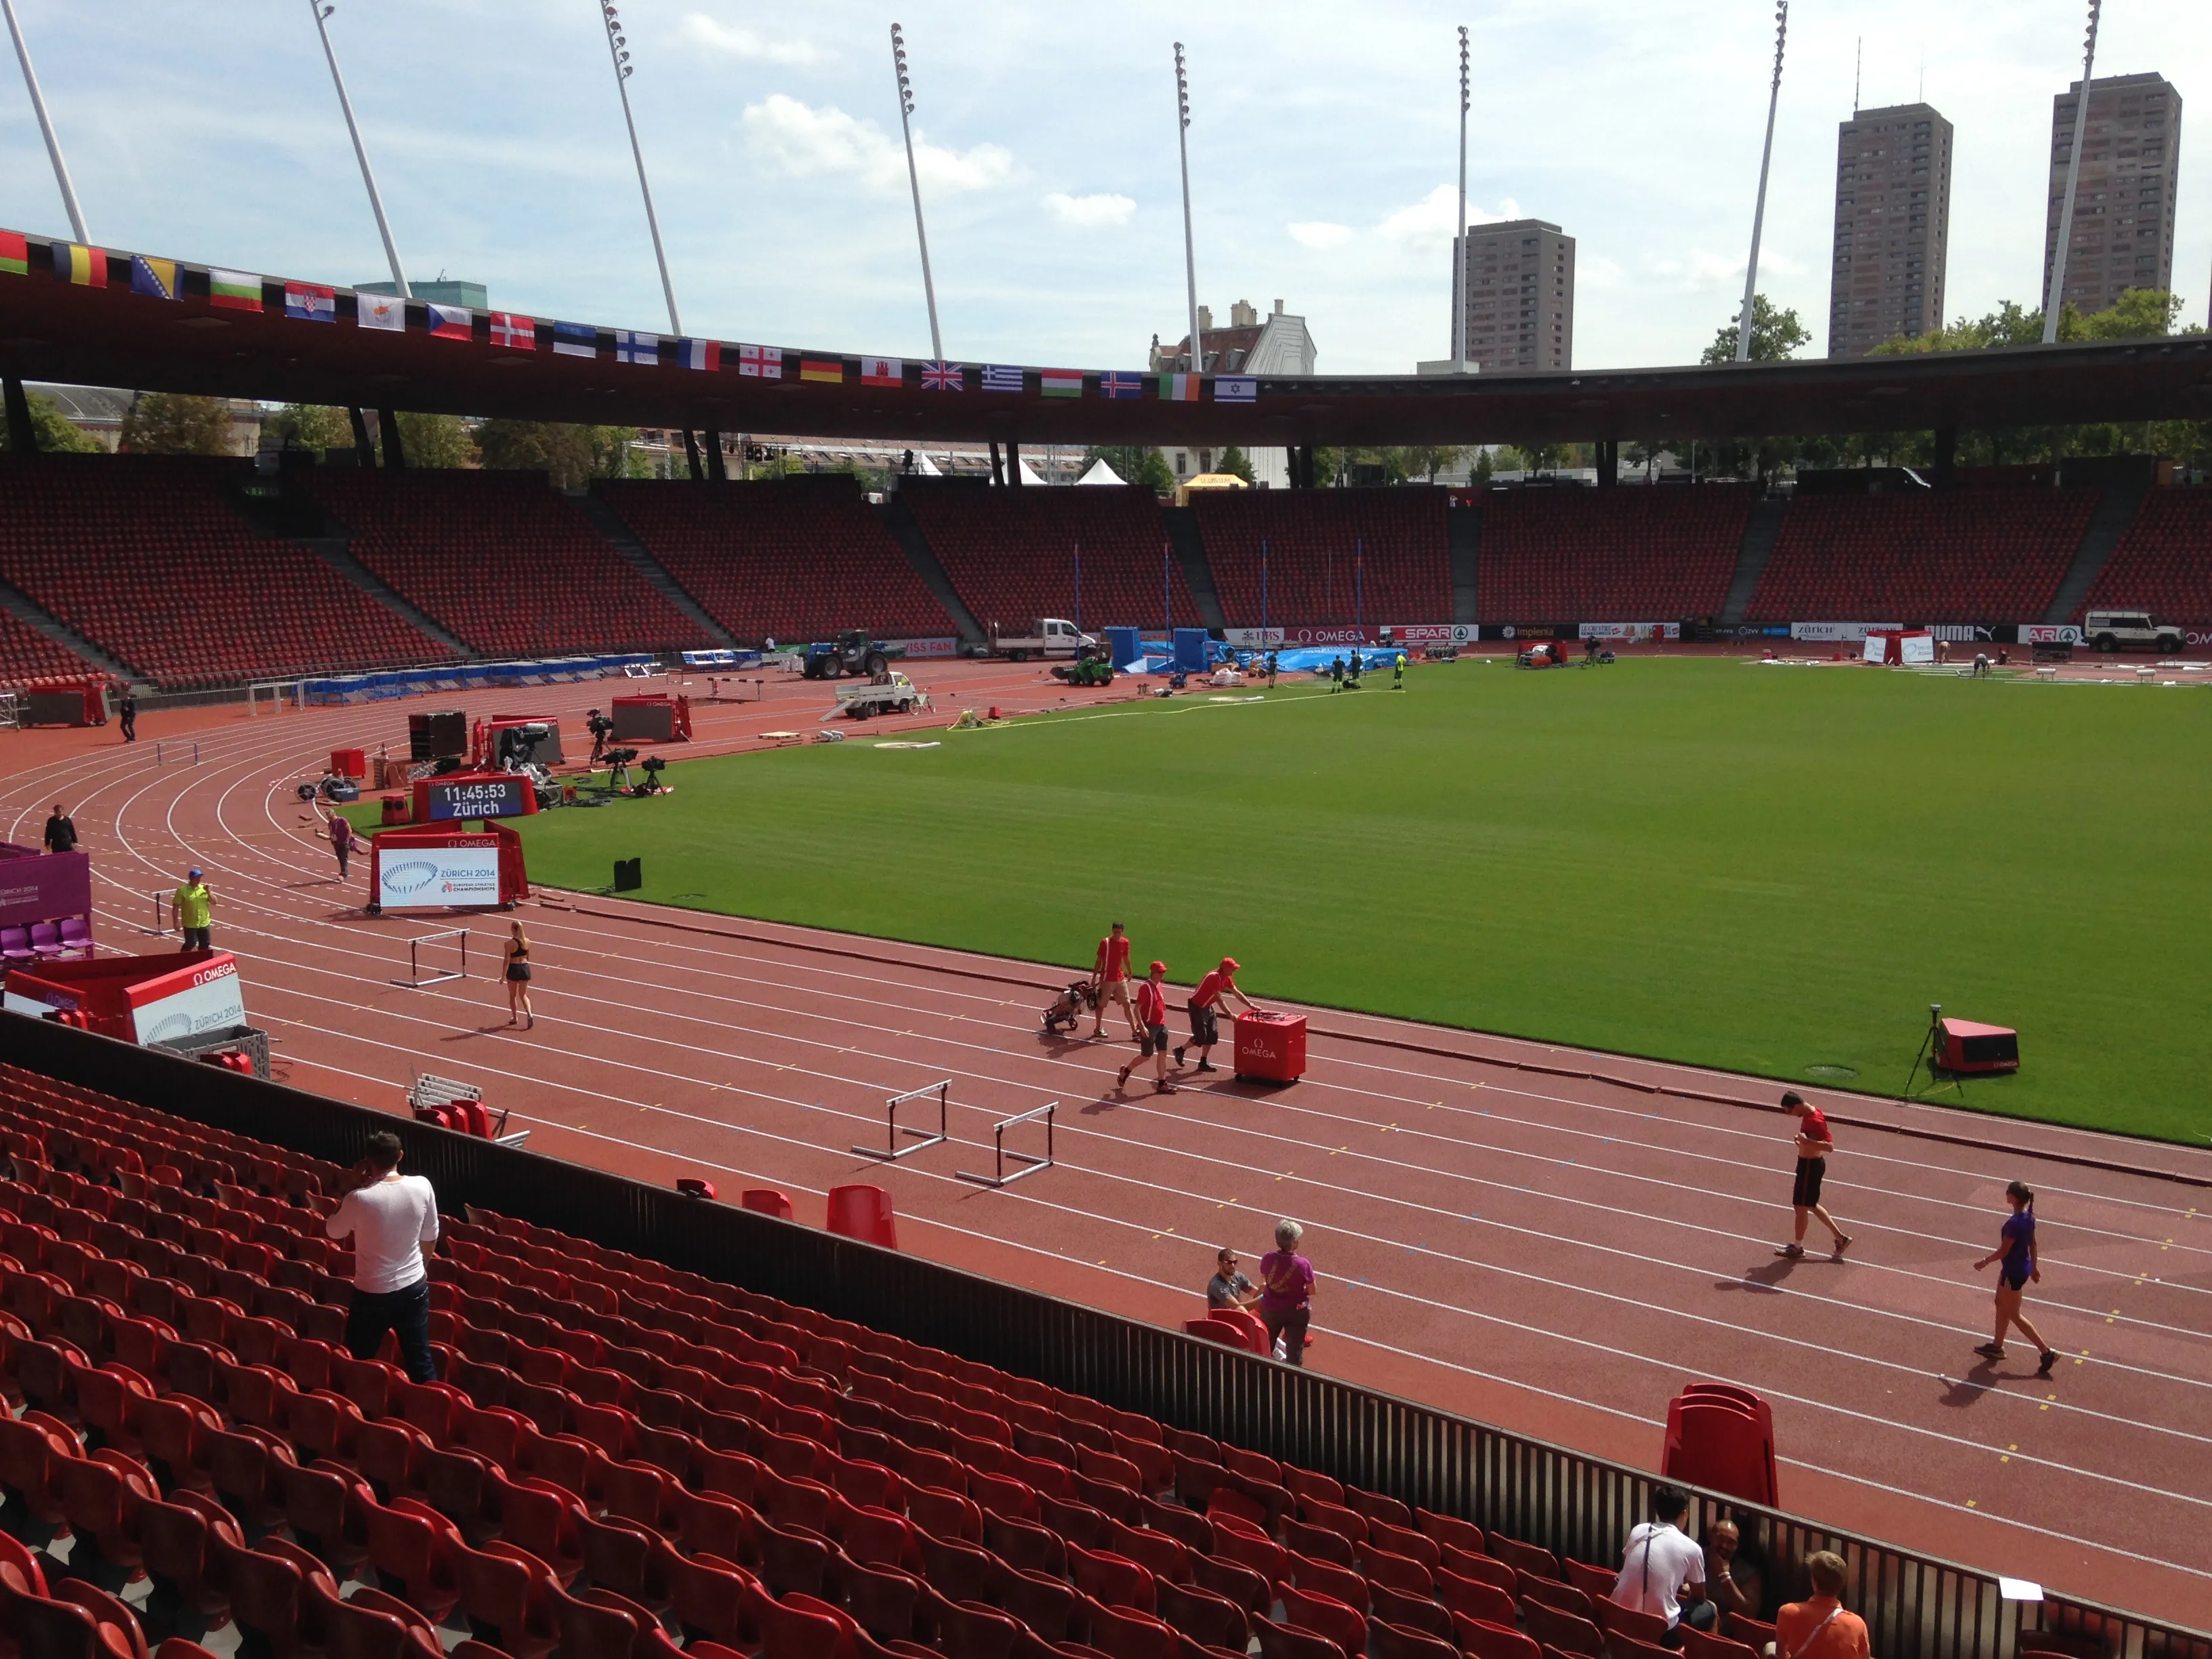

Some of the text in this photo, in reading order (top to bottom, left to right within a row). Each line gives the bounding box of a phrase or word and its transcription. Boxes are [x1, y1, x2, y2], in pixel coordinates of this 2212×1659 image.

[1255, 631, 1279, 641] UBS
[1315, 630, 1366, 642] OMEGA
[1405, 628, 1450, 639] SPAR
[1517, 627, 1554, 638] Implenia
[1924, 625, 1974, 641] PUMA
[930, 642, 951, 652] FAN
[444, 784, 506, 802] 11:45:53
[452, 800, 499, 817] Zürich
[459, 839, 496, 848] OMEGA
[441, 868, 495, 878] ZÜRICH 2014
[203, 962, 237, 982] OMEGA
[194, 1004, 242, 1030] ZÜRICH 2014
[1242, 1046, 1277, 1060] OMEGA
